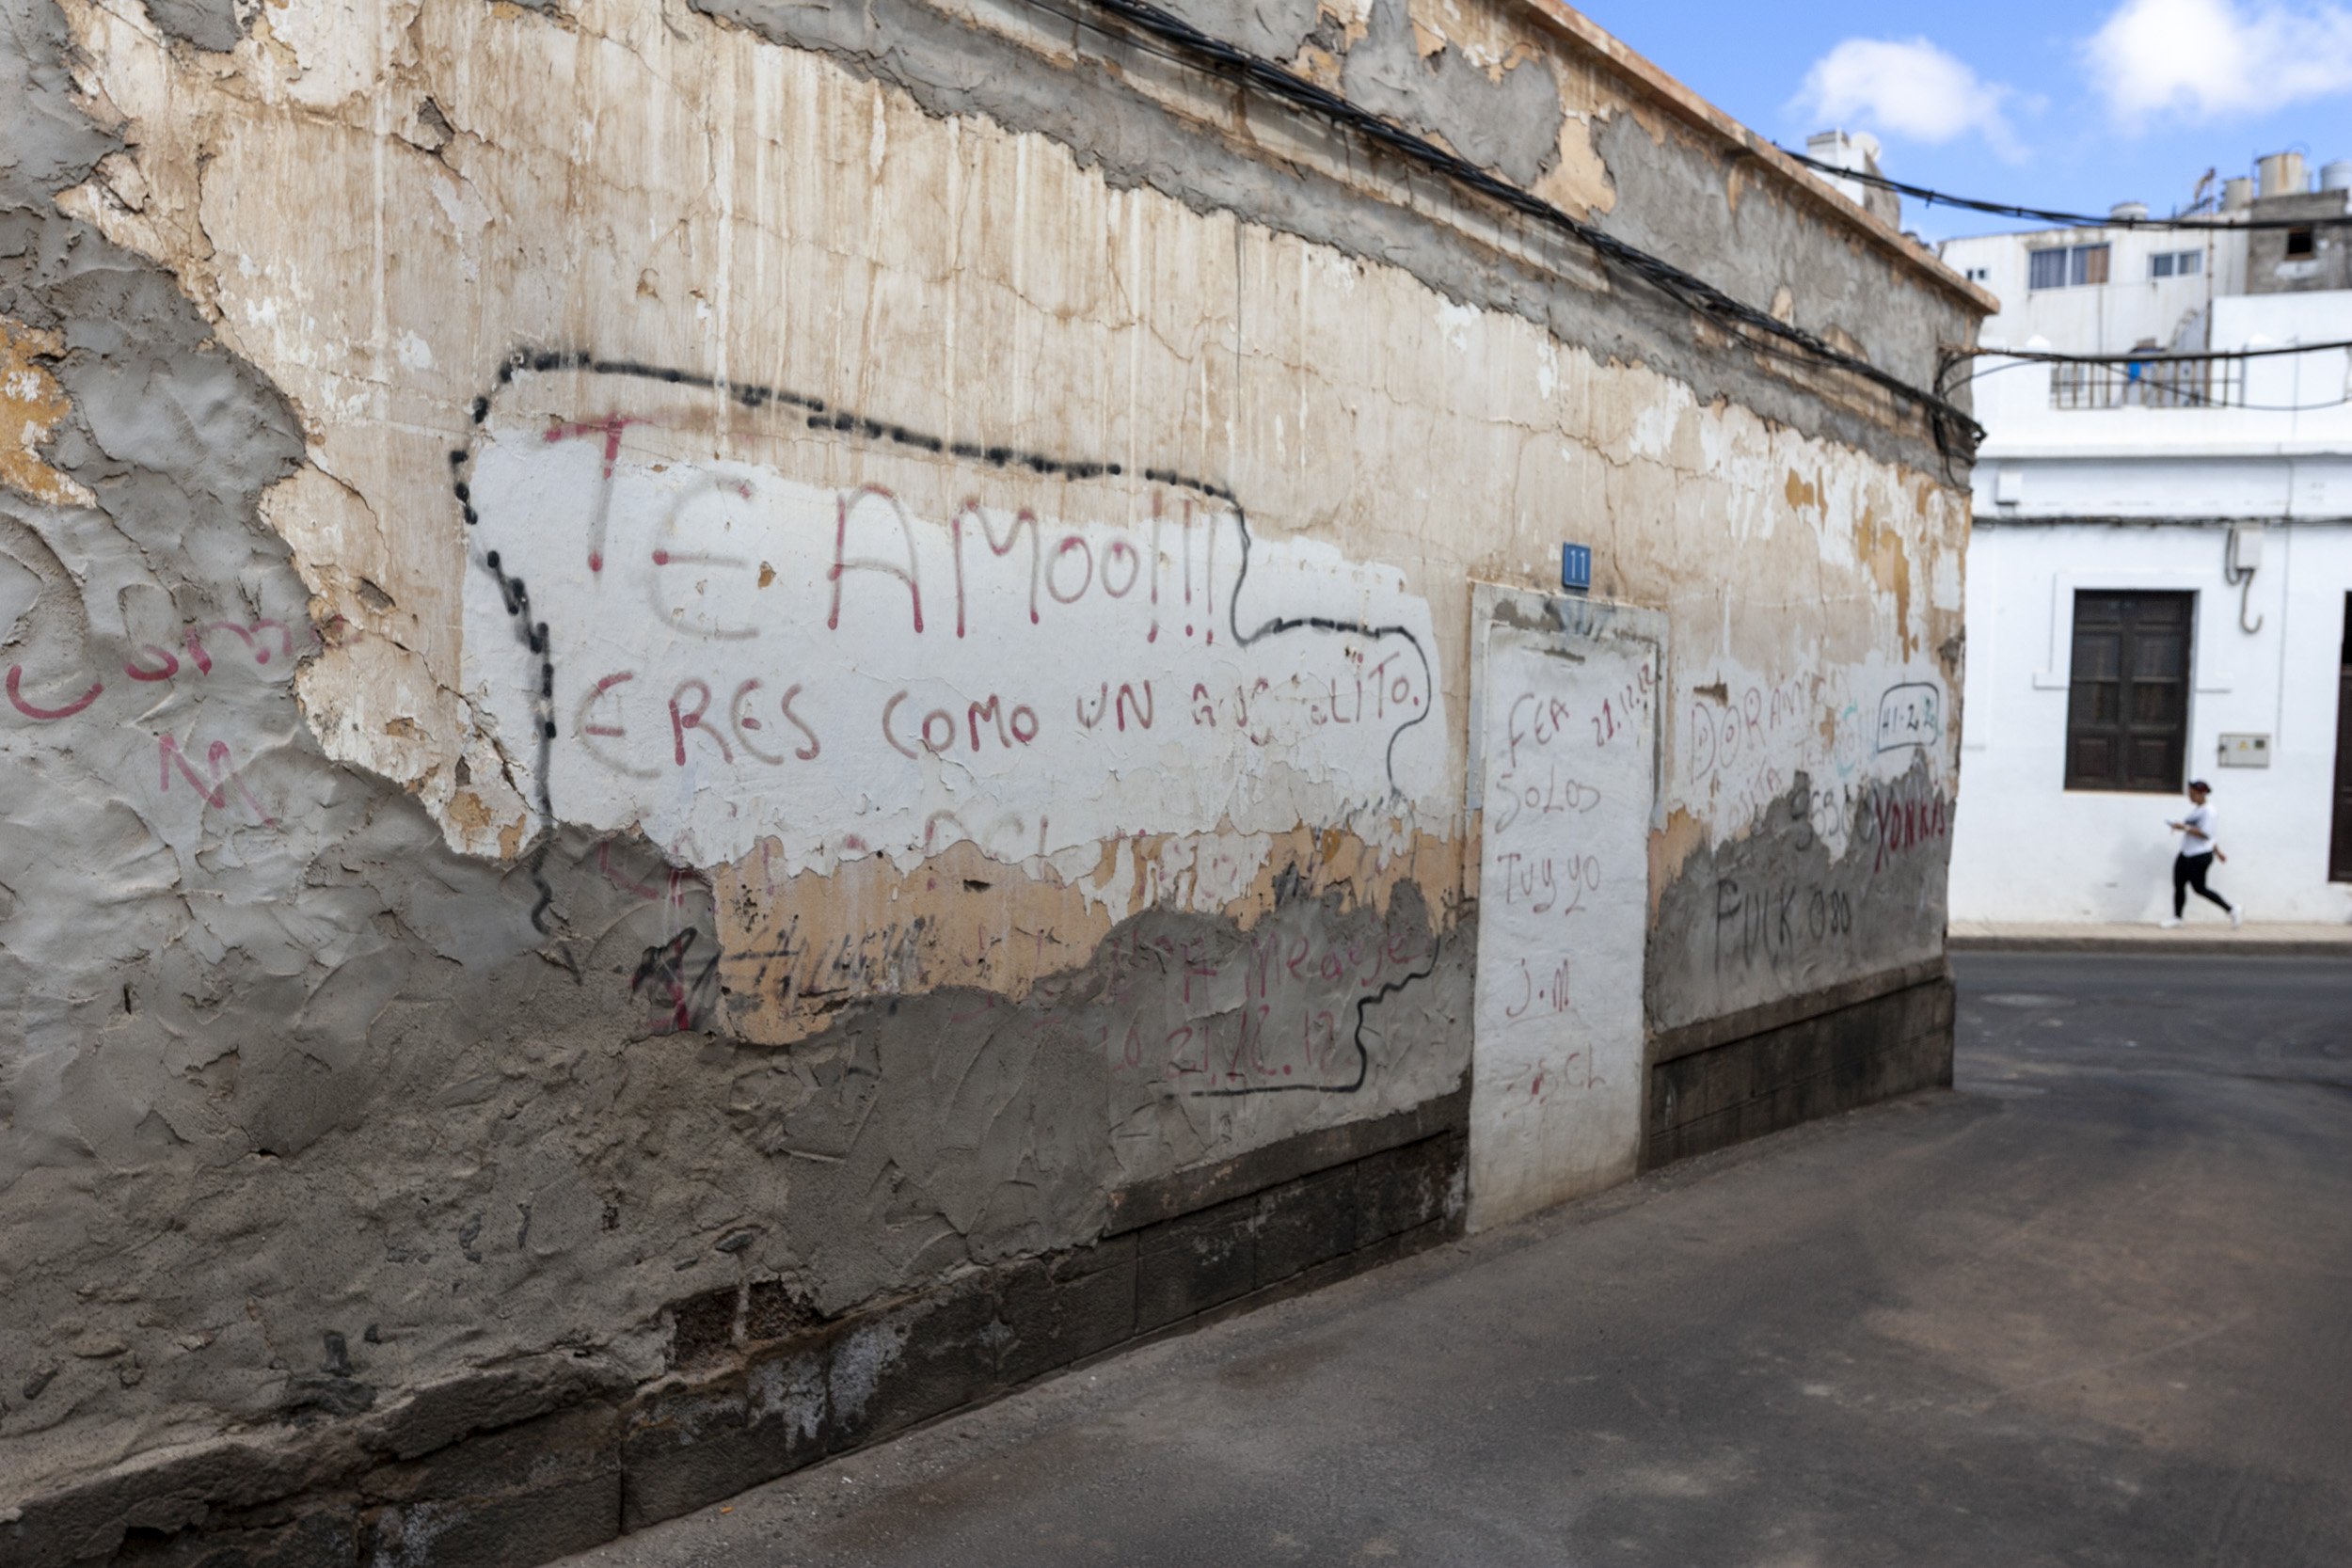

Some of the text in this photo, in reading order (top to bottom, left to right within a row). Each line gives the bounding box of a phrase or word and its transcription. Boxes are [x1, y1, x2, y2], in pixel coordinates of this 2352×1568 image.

[543, 410, 760, 641] TE
[1569, 549, 1586, 581] 11
[576, 670, 821, 779] ERES
[882, 689, 1039, 760] COMO
[1076, 679, 1153, 732] UN
